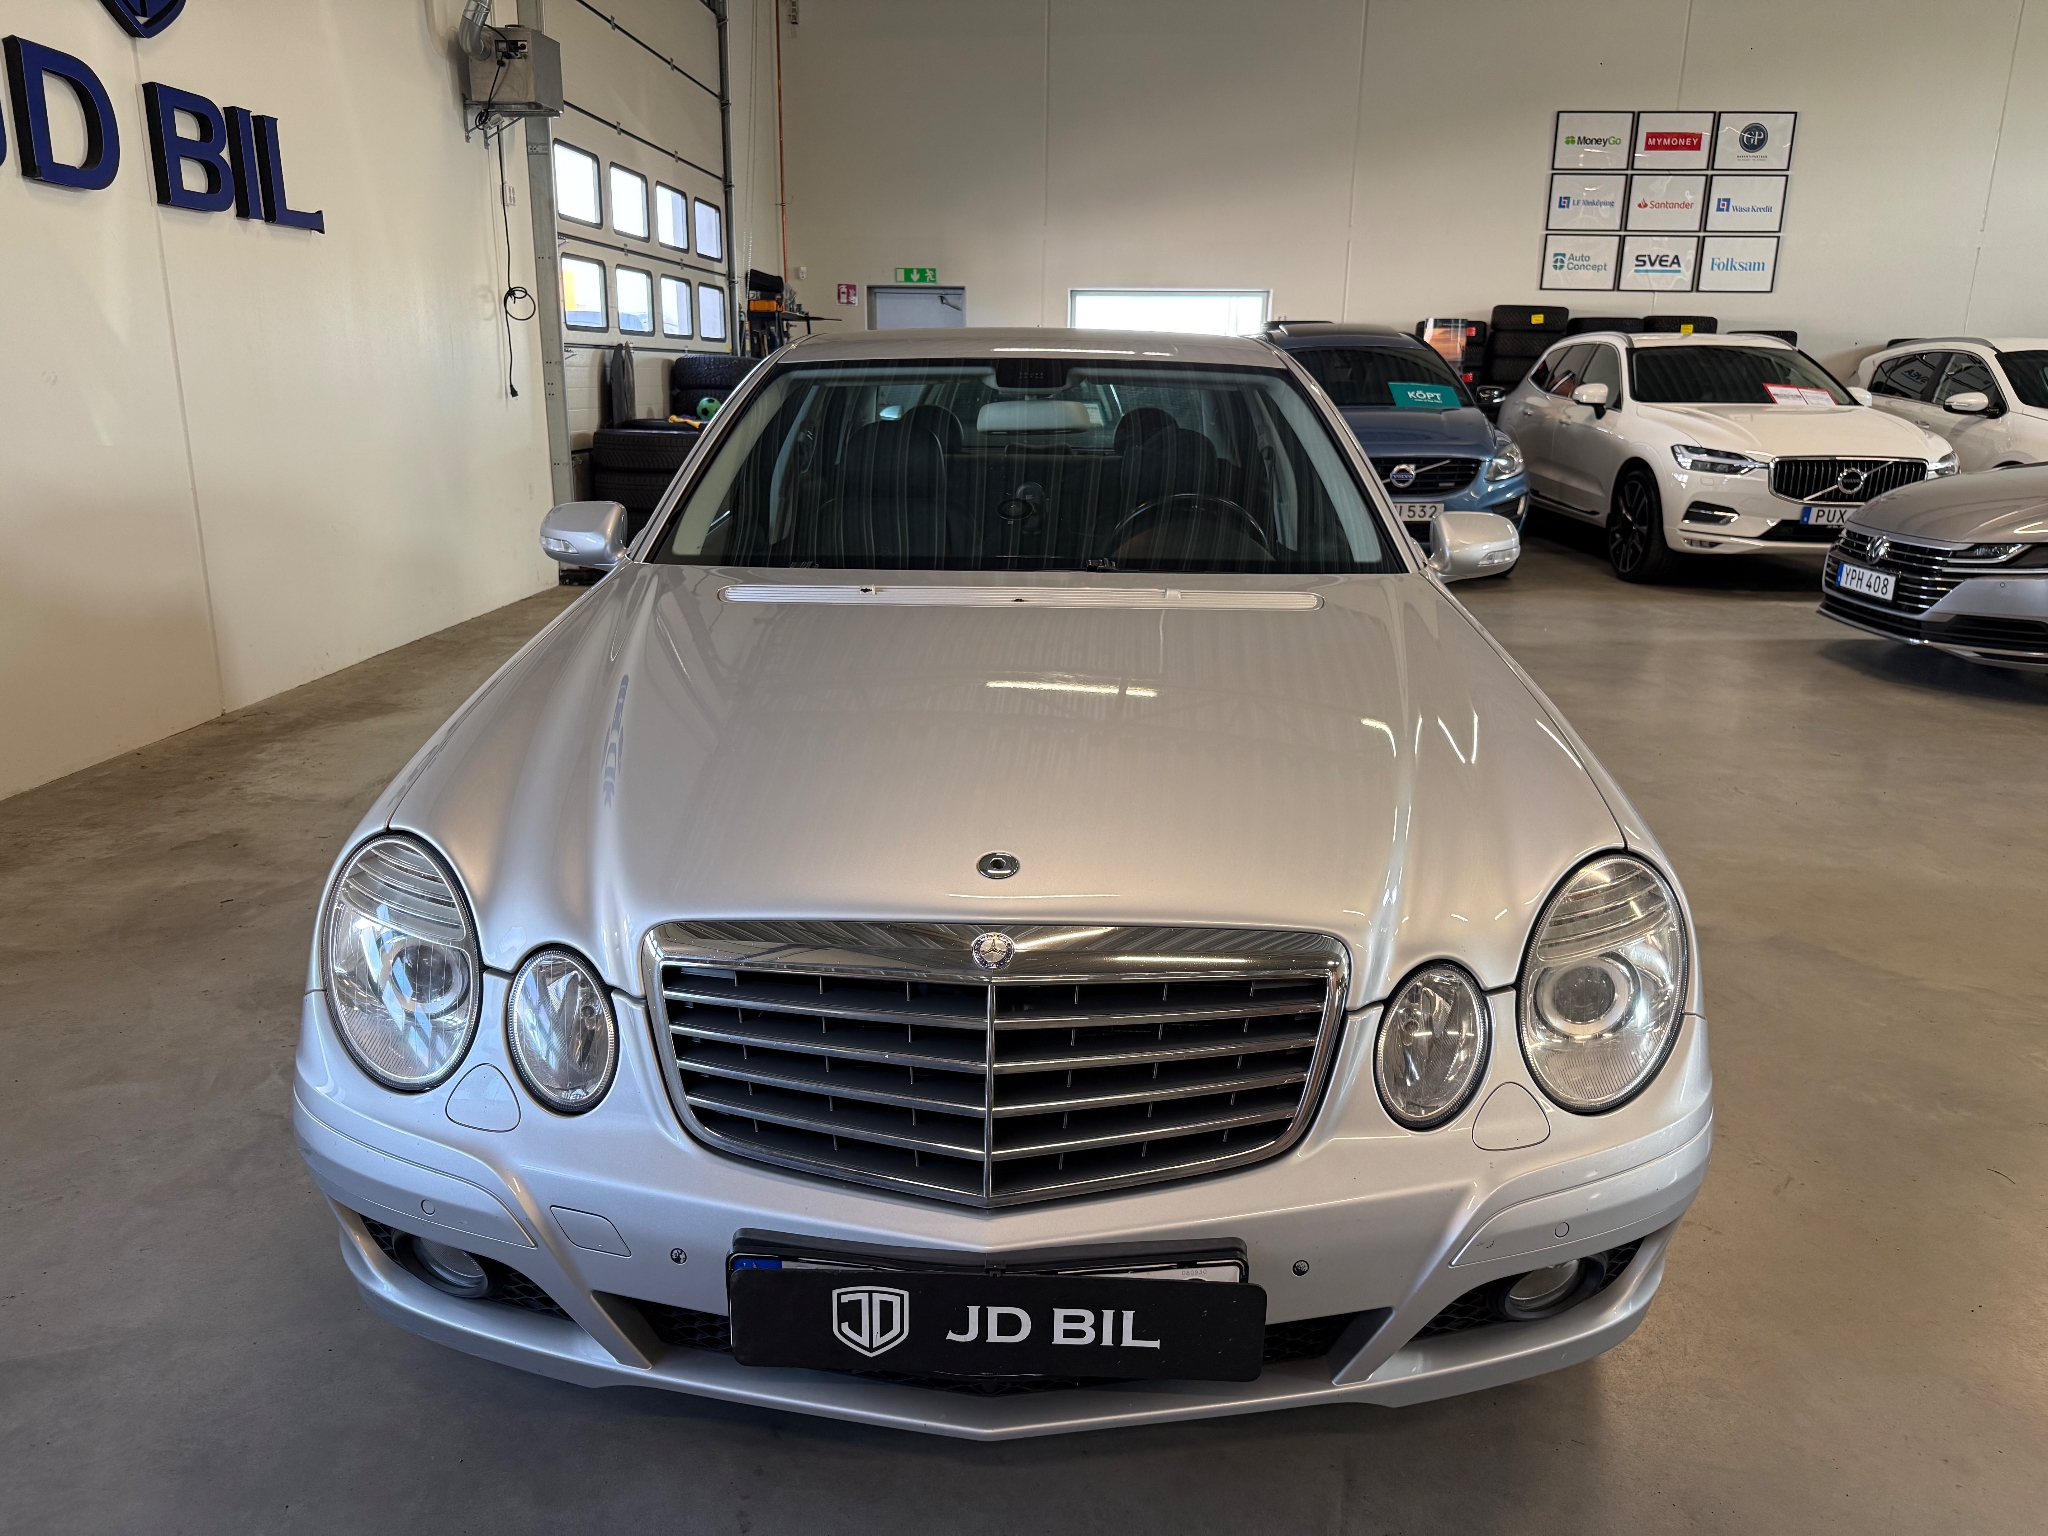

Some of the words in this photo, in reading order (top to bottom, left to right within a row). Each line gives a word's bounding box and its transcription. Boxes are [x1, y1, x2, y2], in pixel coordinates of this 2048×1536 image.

[0, 35, 120, 190] D
[143, 81, 325, 234] BIL
[1577, 135, 1622, 147] MoneyGo
[1647, 137, 1698, 146] MYMONEY
[1649, 200, 1694, 209] Santander
[1732, 205, 1751, 213] Wasa
[1751, 205, 1773, 213] Kredit
[1567, 253, 1591, 262] Auto
[1634, 254, 1681, 268] SVEA
[1566, 262, 1608, 273] Concept
[1710, 257, 1766, 272] Folksam
[1407, 390, 1442, 401] KÖPT
[1407, 505, 1438, 519] 532
[1815, 509, 1847, 523] PUX
[1845, 566, 1865, 590] YPH
[1866, 573, 1889, 596] 408
[946, 1305, 1032, 1343] JD
[1051, 1307, 1161, 1350] BIL
